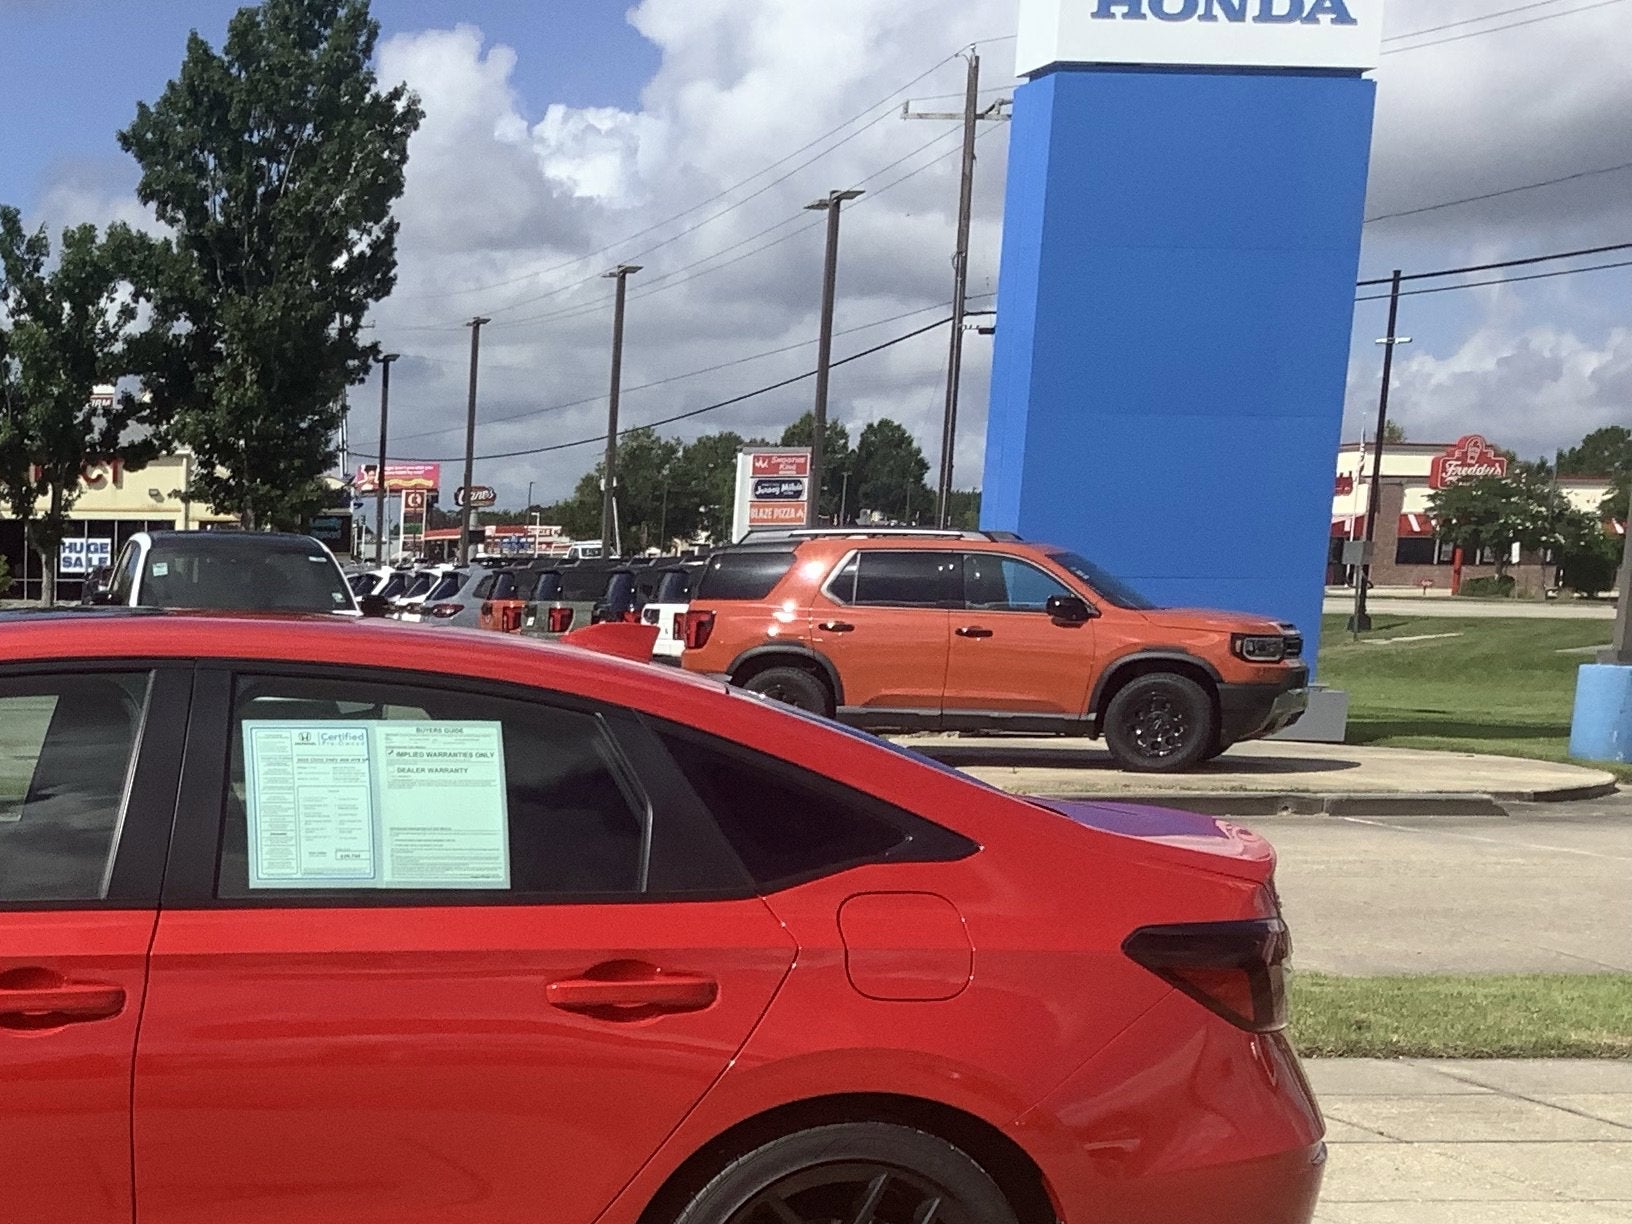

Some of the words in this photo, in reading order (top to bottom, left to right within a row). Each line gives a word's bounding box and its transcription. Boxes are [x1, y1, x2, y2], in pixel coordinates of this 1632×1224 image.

[1091, 0, 1358, 25] HONDA
[751, 507, 772, 519] BLAZE
[772, 507, 795, 519] PIZZA
[62, 542, 109, 554] HUGE
[62, 556, 108, 568] SALE
[321, 731, 364, 740] Certified
